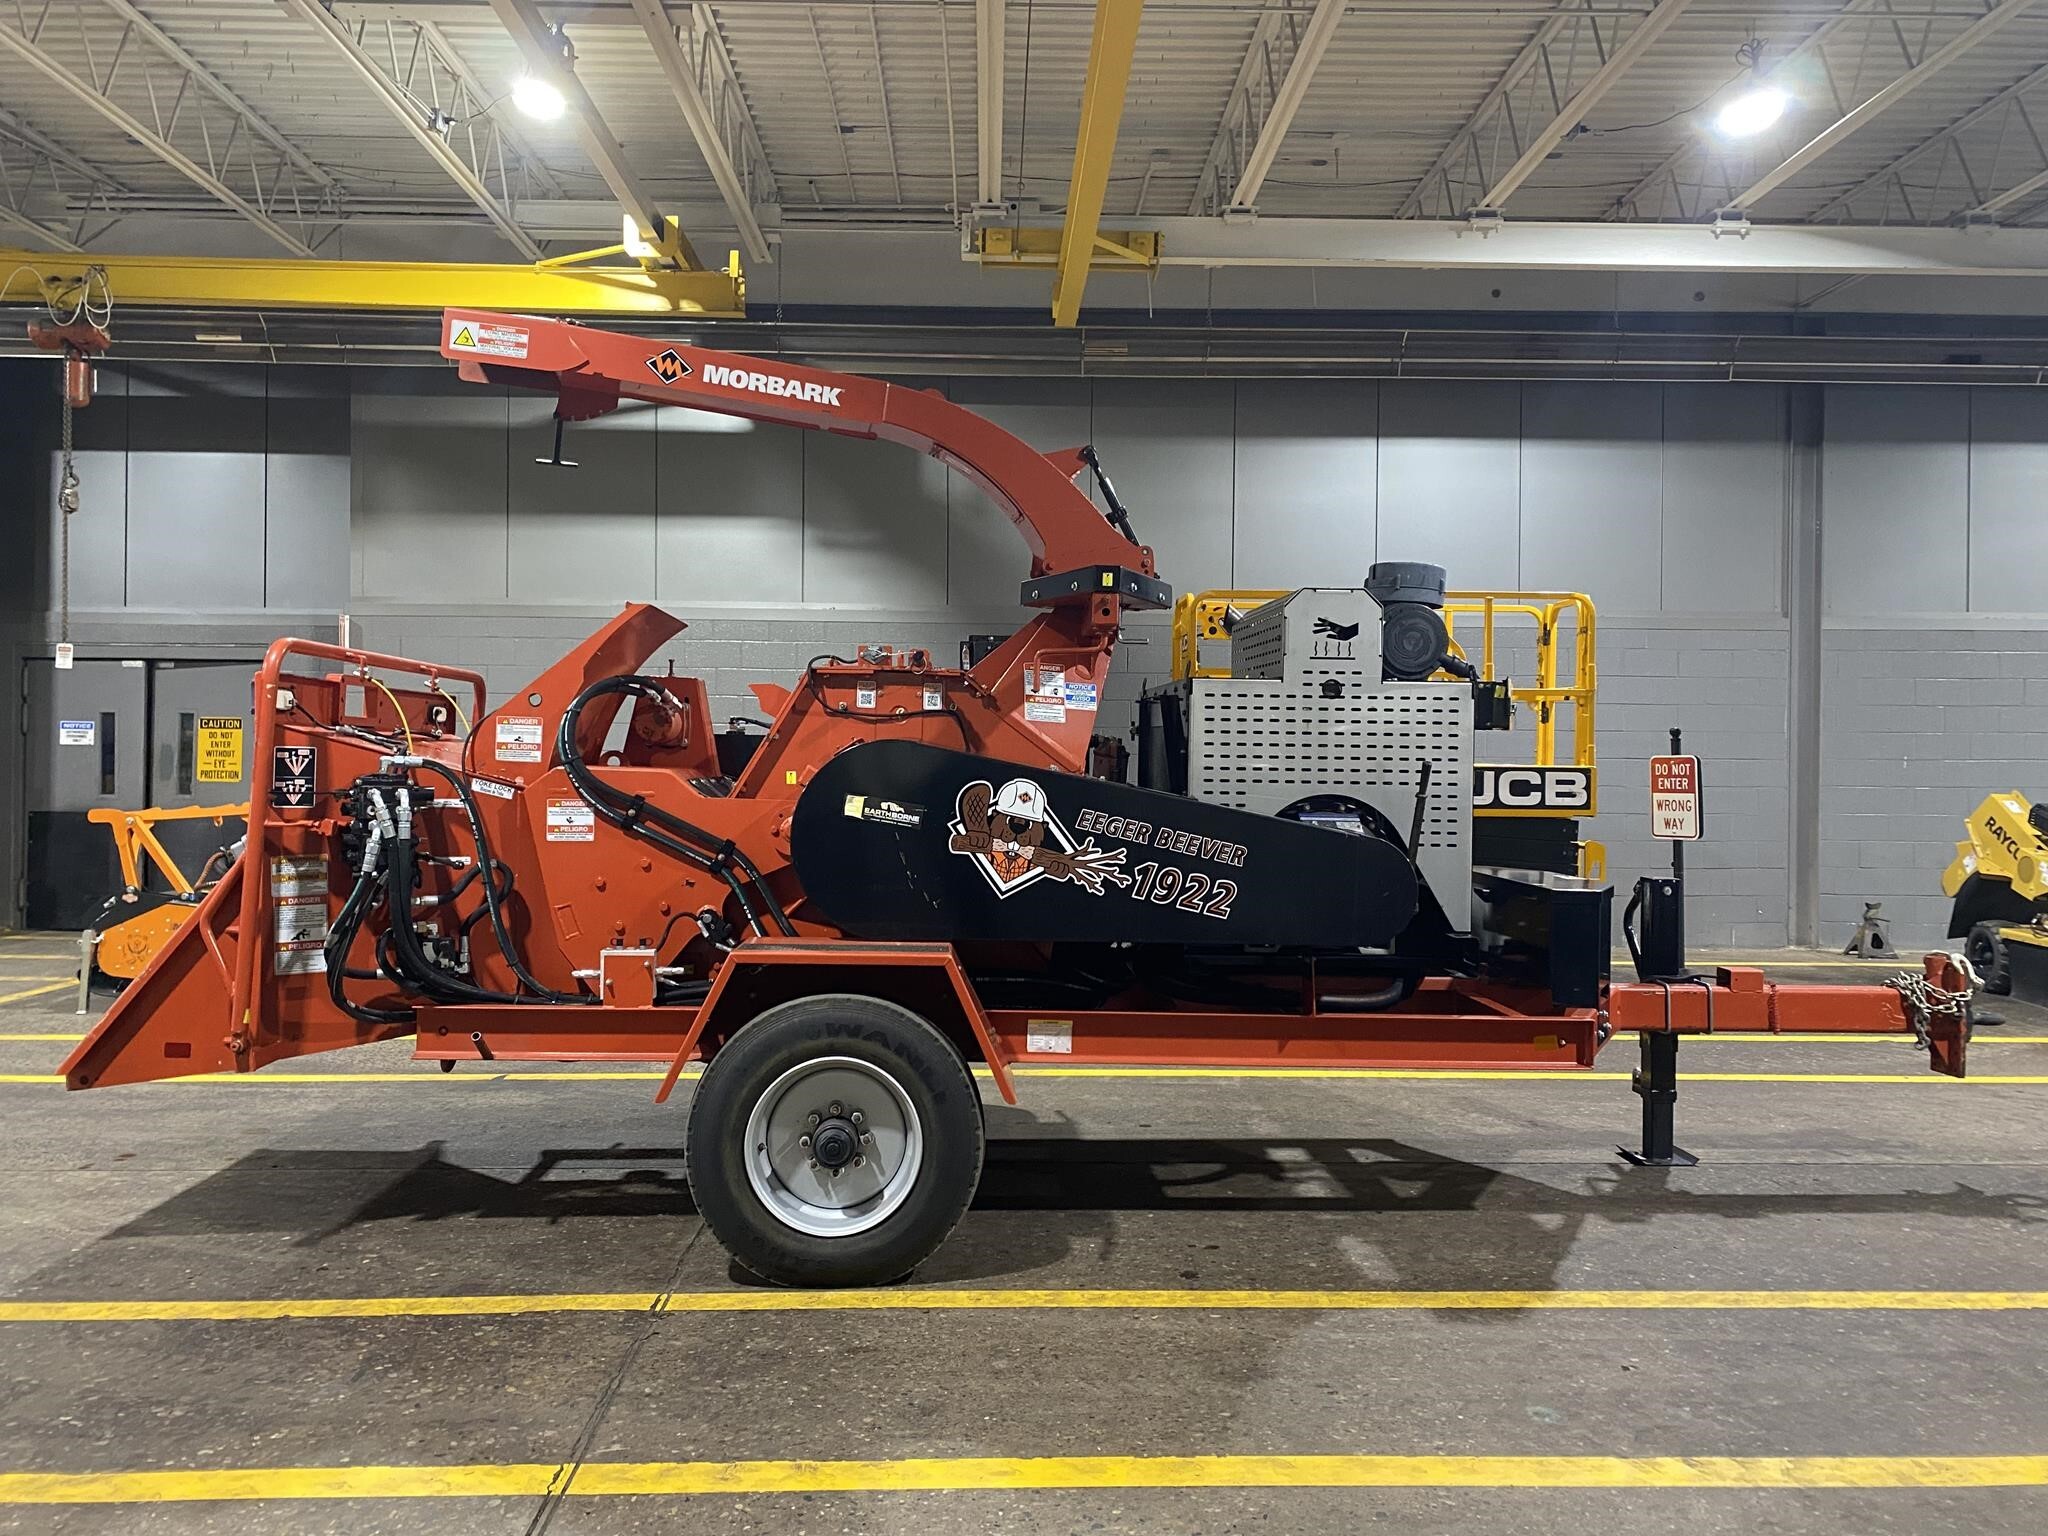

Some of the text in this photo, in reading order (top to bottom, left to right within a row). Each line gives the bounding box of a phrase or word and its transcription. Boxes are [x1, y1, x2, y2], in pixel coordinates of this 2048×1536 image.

[703, 364, 841, 406] MORBARK
[202, 719, 240, 728] CAUTION
[208, 731, 233, 739] DO NOT
[211, 740, 232, 748] ENTER
[206, 750, 235, 758] WITHOUT
[214, 759, 226, 769] EYE
[1655, 764, 1691, 776] DO NOT
[200, 769, 240, 780] PROTECTION
[475, 780, 493, 790] YOKE
[494, 784, 512, 793] LOCK
[1473, 770, 1588, 806] JCB
[1658, 778, 1689, 790] ENTER
[1656, 799, 1692, 812] WRONG
[864, 807, 920, 823] EARTHBORNE
[1664, 818, 1684, 830] WAY
[1075, 808, 1248, 867] EEGER BEEVER
[1131, 861, 1238, 920] 1922
[288, 896, 320, 905] DANGER
[288, 942, 323, 950] PELIGRO
